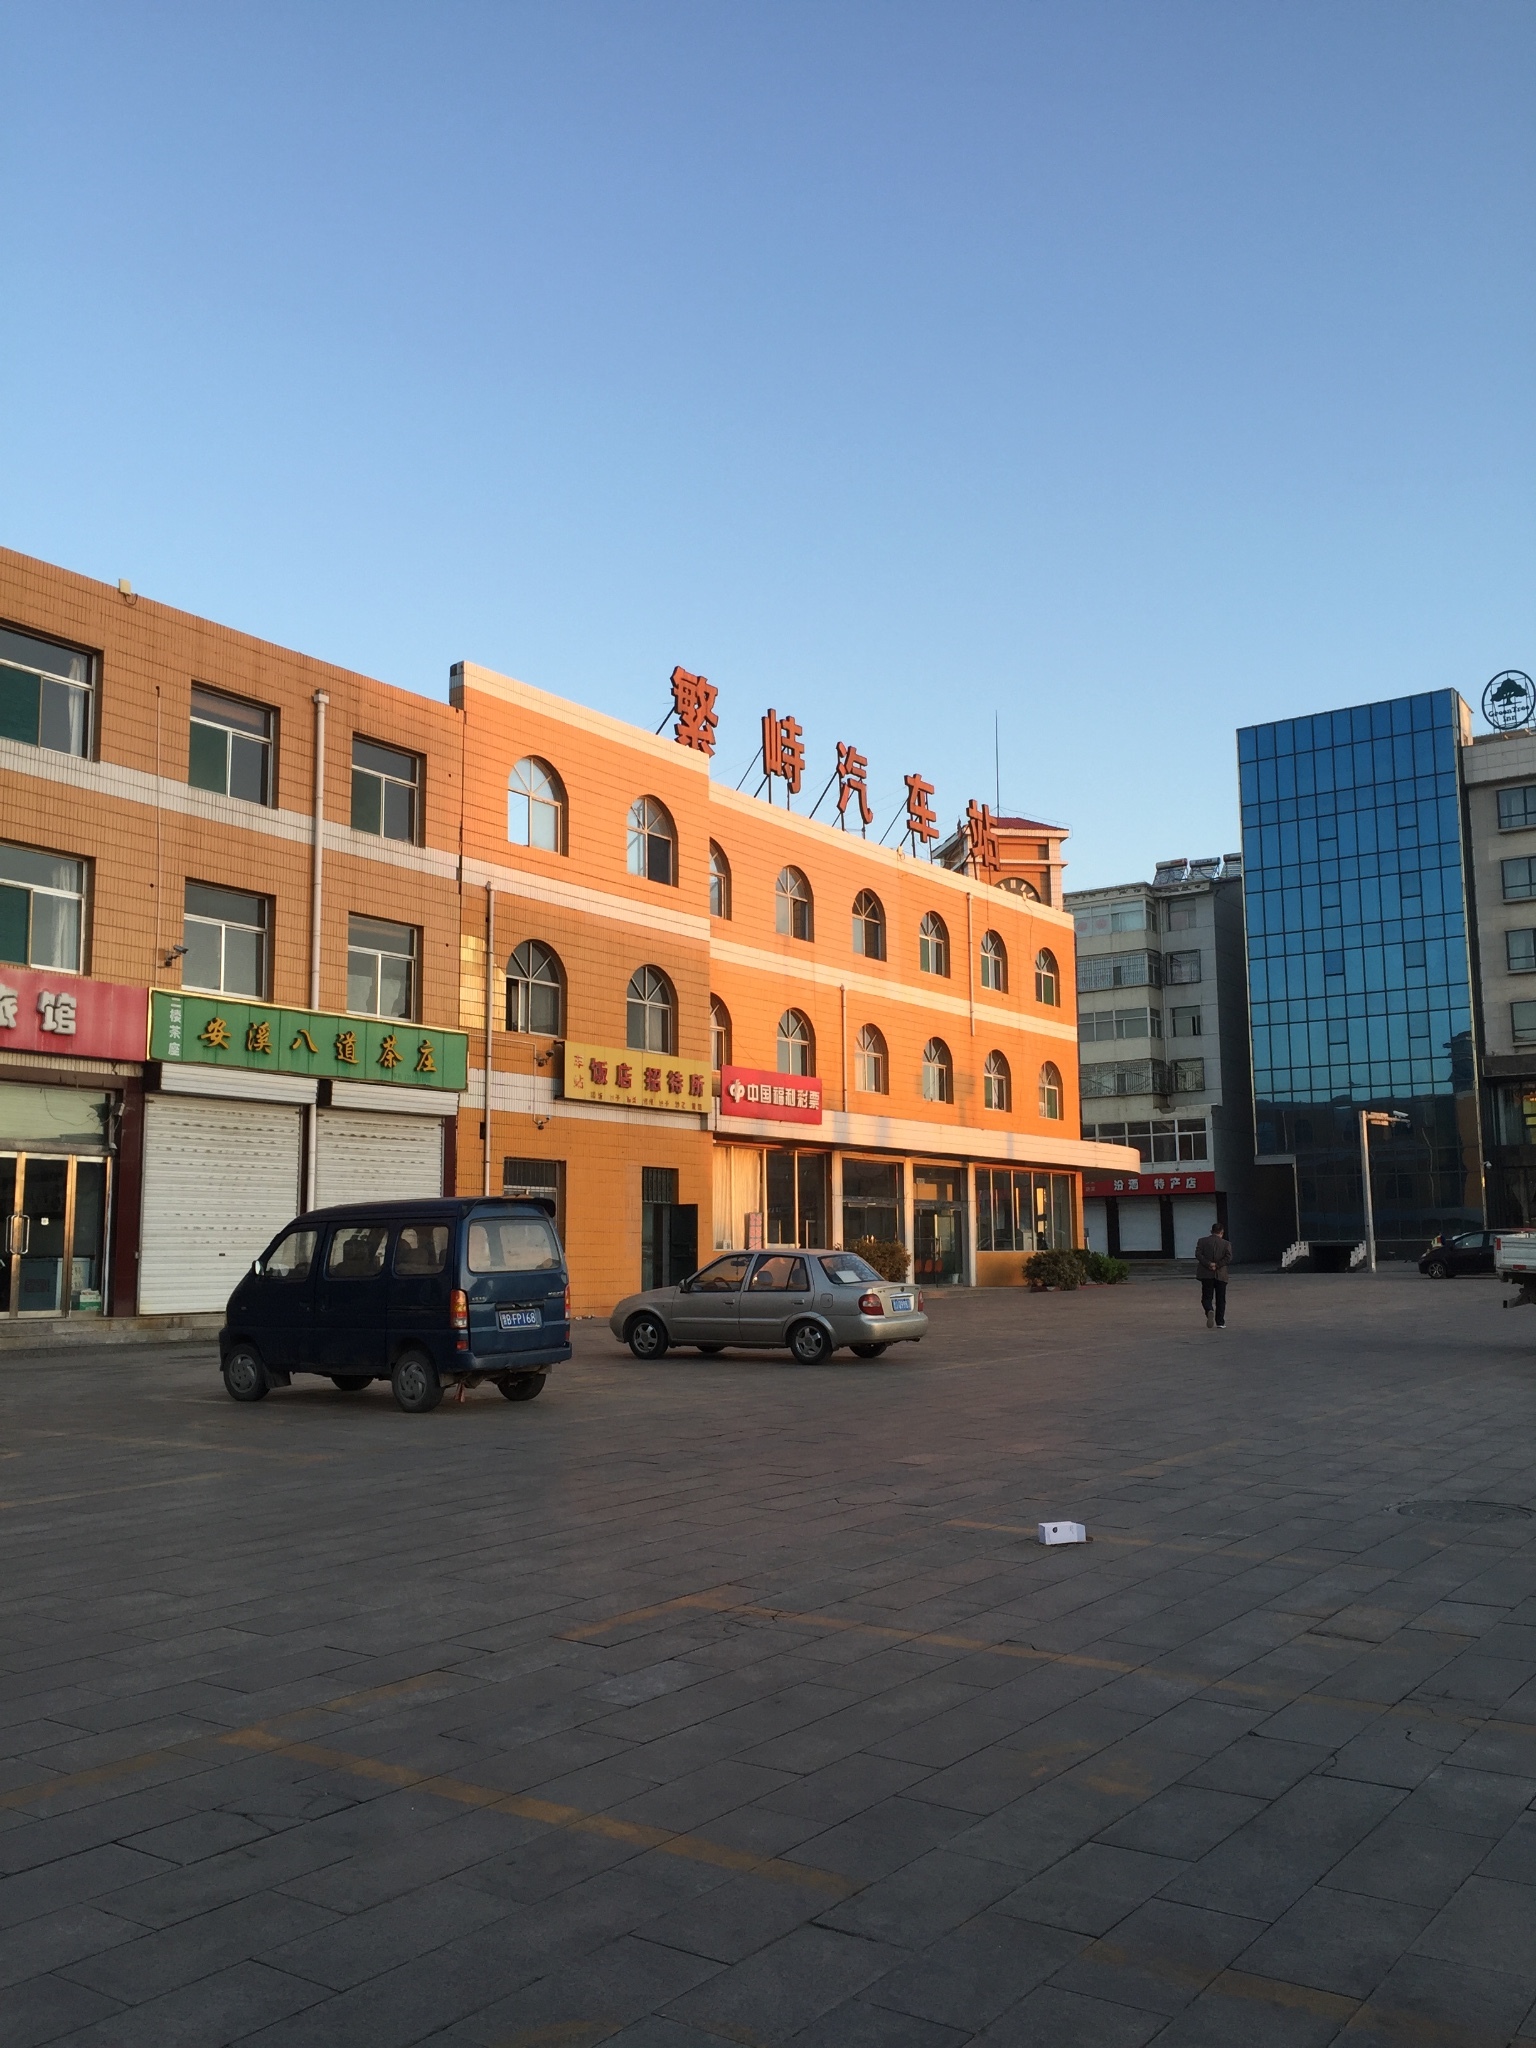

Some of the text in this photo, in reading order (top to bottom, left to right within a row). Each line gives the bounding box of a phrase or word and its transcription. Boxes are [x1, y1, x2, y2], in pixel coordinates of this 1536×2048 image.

[1488, 705, 1530, 717] GreenTree
[670, 666, 1001, 871] 繁峙汽车站
[168, 997, 182, 1057] 二楼茶座
[199, 1017, 438, 1074] 安溪八道茶庄
[747, 1083, 820, 1110] 中国福利彩票
[1154, 1177, 1197, 1190] 特产店
